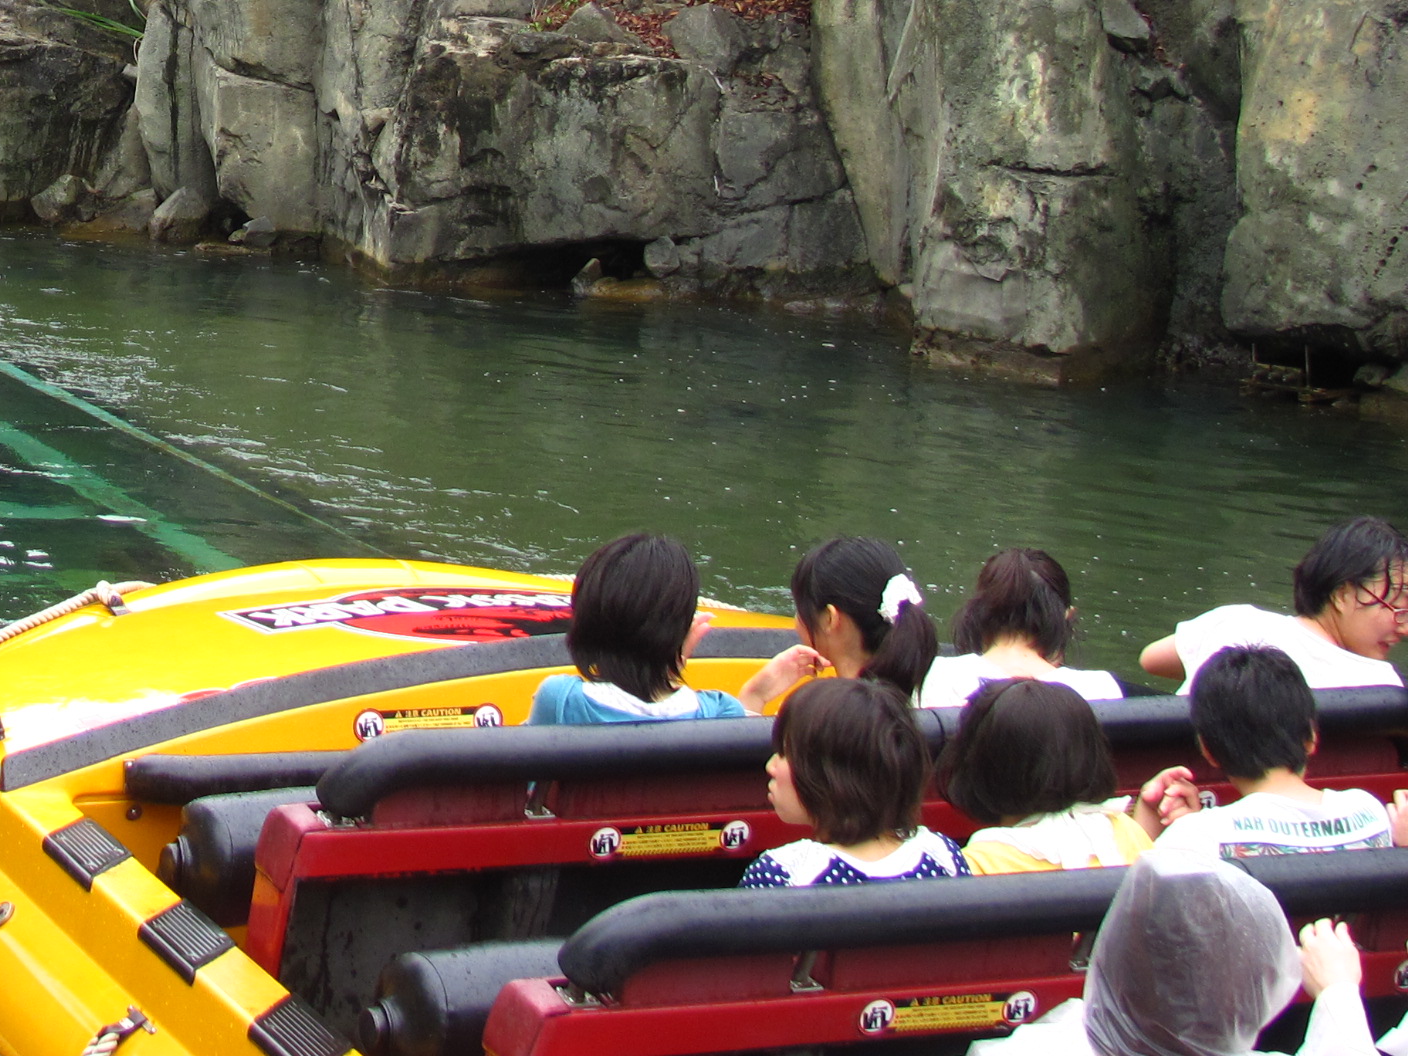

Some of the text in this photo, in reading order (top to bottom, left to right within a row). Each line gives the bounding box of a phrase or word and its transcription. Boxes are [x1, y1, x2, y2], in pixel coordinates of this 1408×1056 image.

[248, 594, 571, 627] ASSIC PARK
[421, 707, 462, 717] CAUTION
[664, 822, 709, 832] CAUTION
[1268, 807, 1378, 837] OUTERNATIONAL
[942, 993, 992, 1005] CAUTION
